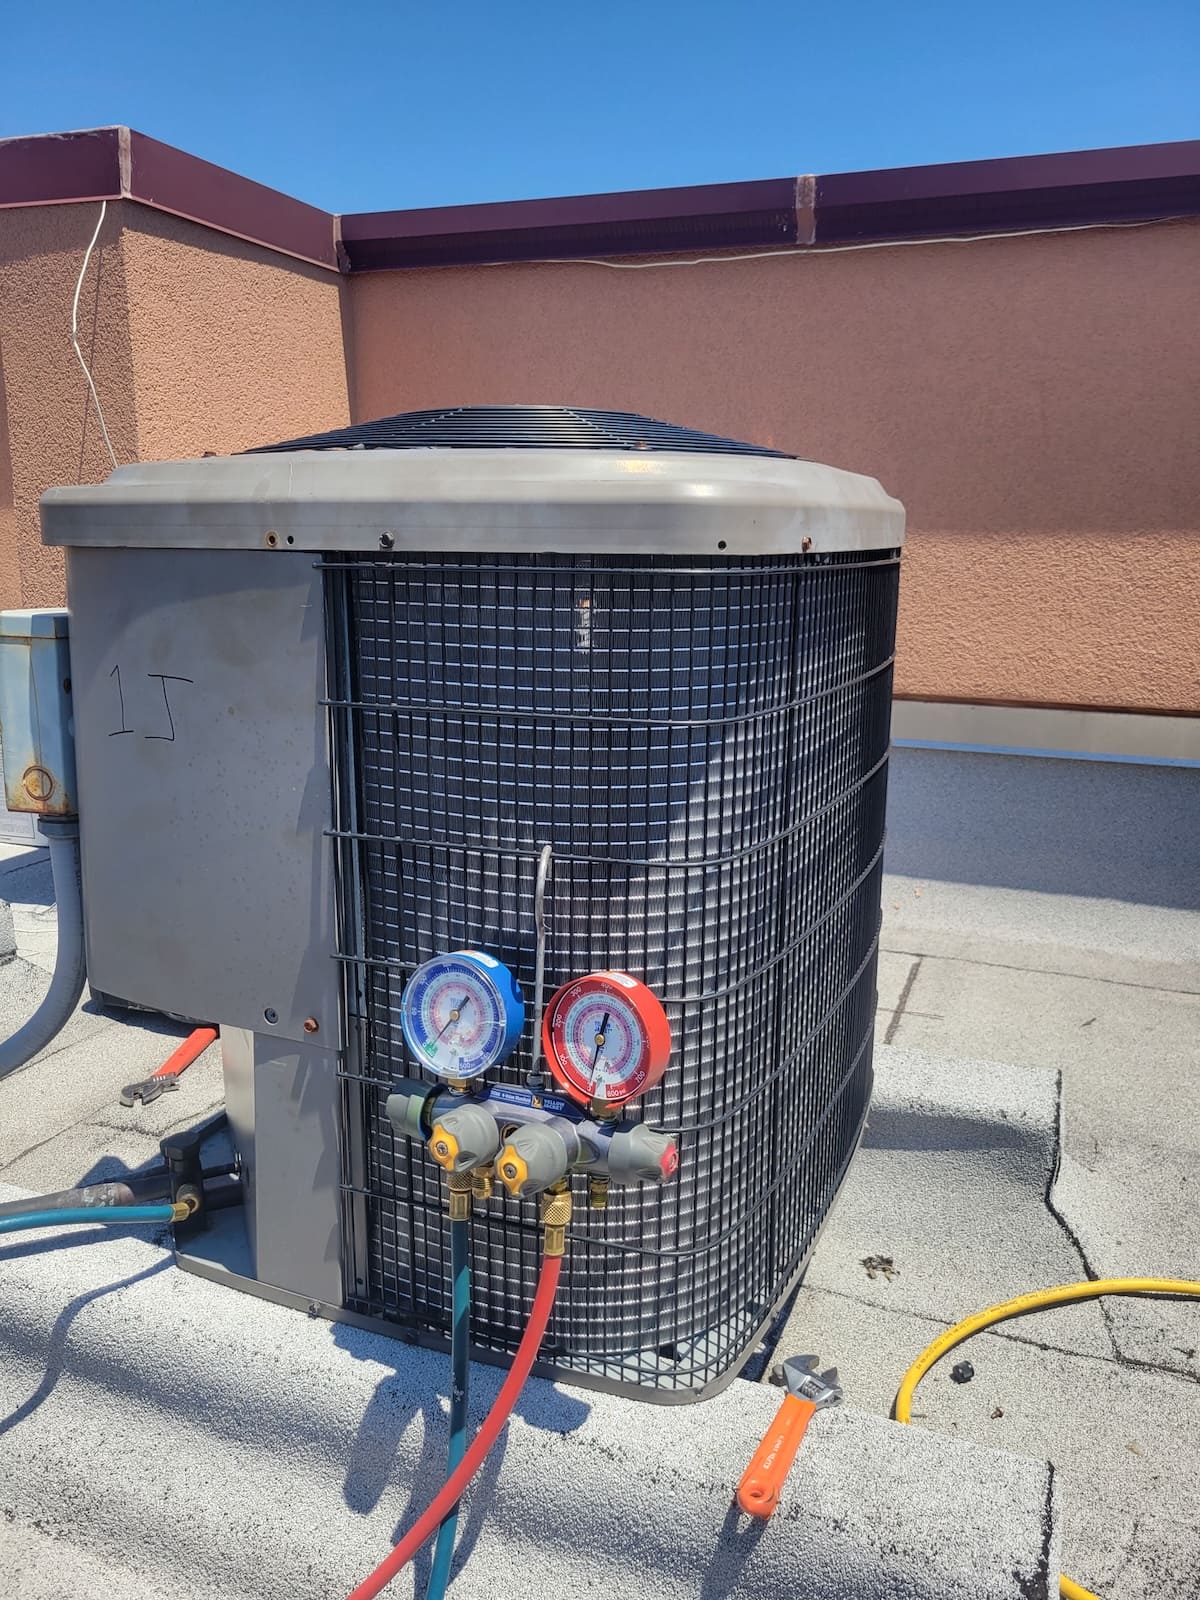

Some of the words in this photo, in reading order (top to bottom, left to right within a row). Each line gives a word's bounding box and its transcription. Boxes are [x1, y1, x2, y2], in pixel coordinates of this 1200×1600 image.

[570, 986, 581, 997] 300
[555, 1013, 563, 1028] 200
[559, 1053, 567, 1065] 100
[635, 1071, 645, 1083] 700
[607, 1090, 620, 1098] 800
[544, 1098, 566, 1106] YELLOW
